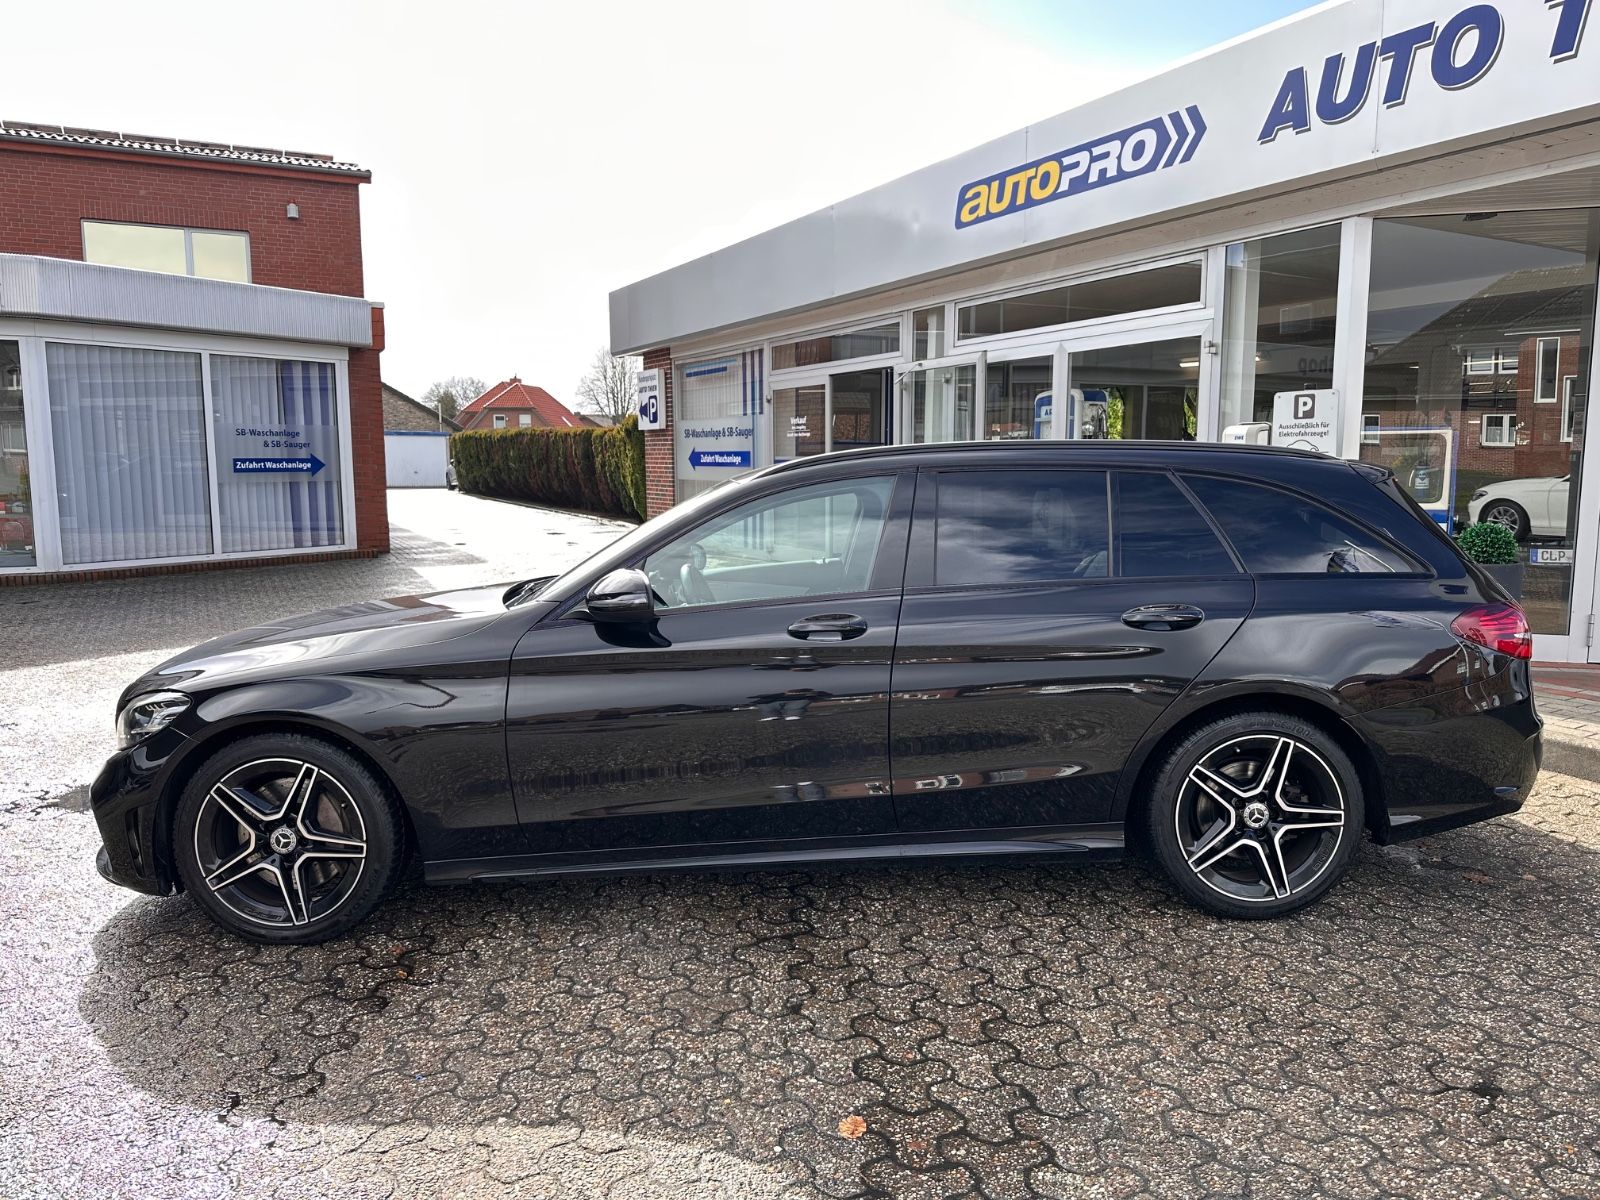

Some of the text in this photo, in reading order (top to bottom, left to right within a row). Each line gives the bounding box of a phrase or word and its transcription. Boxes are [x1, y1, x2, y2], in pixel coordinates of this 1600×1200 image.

[1257, 4, 1505, 145] AUTO
[650, 400, 656, 421] P
[1298, 396, 1312, 417] P
[1278, 422, 1320, 430] Ausschließlich
[235, 428, 300, 438] SB-Waschanlage
[684, 426, 753, 440] SB-Waschanlage & SB-Sauger
[271, 440, 311, 448] SB-Sauger
[236, 460, 311, 469] Zufahrt Waschanlage
[714, 454, 741, 465] Waschanlage
[1541, 550, 1566, 561] CLP
